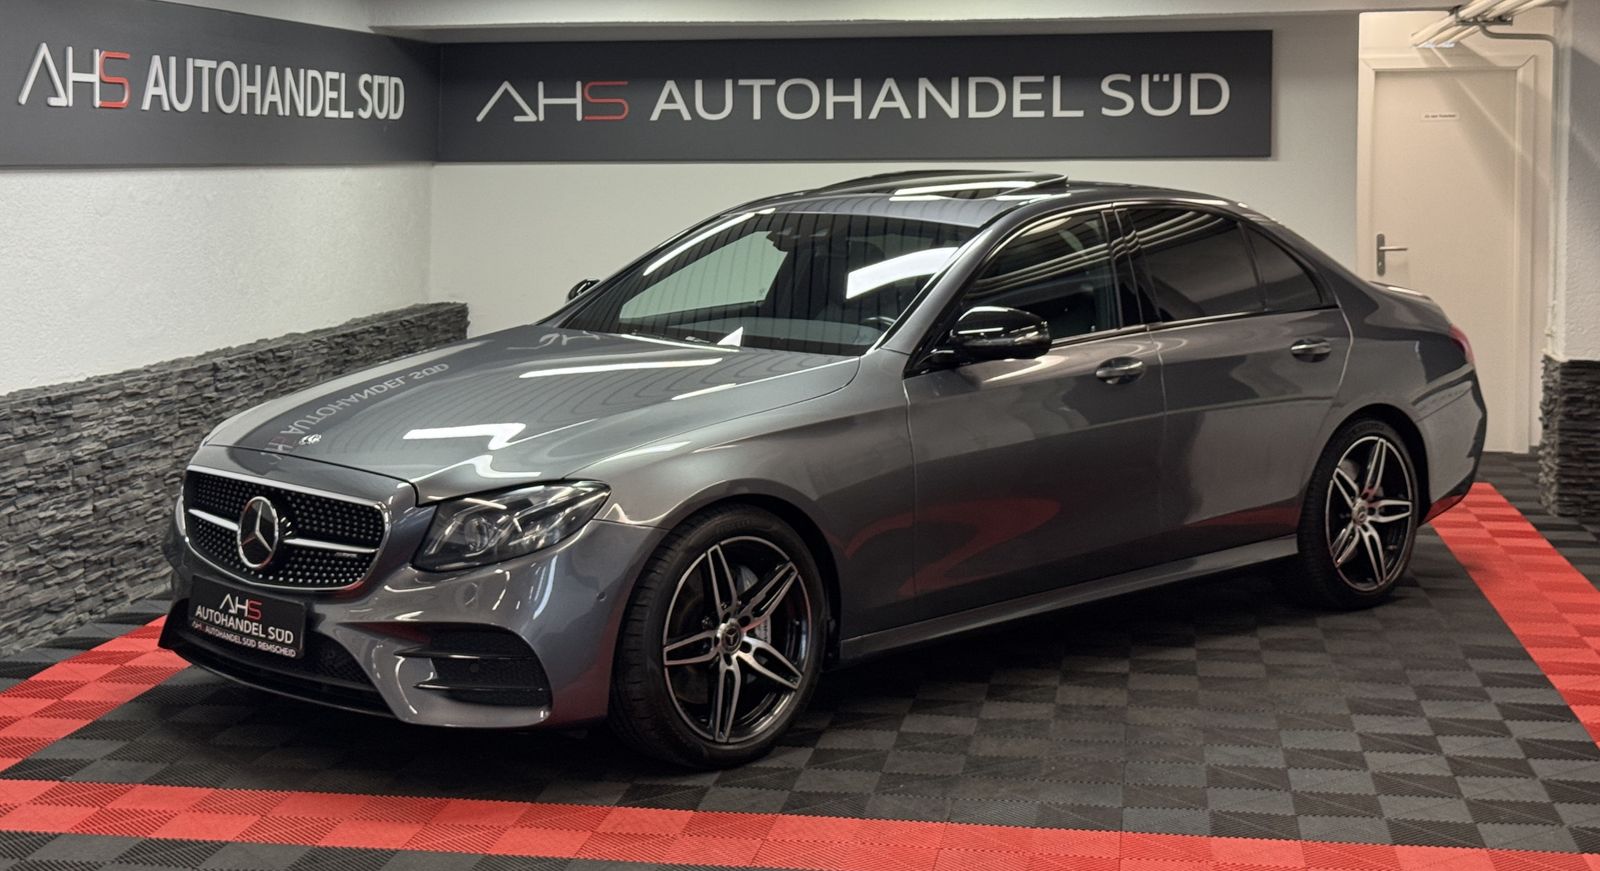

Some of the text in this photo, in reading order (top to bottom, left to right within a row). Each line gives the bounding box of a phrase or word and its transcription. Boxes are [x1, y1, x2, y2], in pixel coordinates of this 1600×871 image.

[19, 43, 405, 120] AHS AUTOHANDEL SÜD
[476, 73, 1231, 123] AHS AUTOHANDEL SÜD
[195, 605, 293, 644] AUTOHANDEL SÜD
[220, 593, 262, 619] AHS
